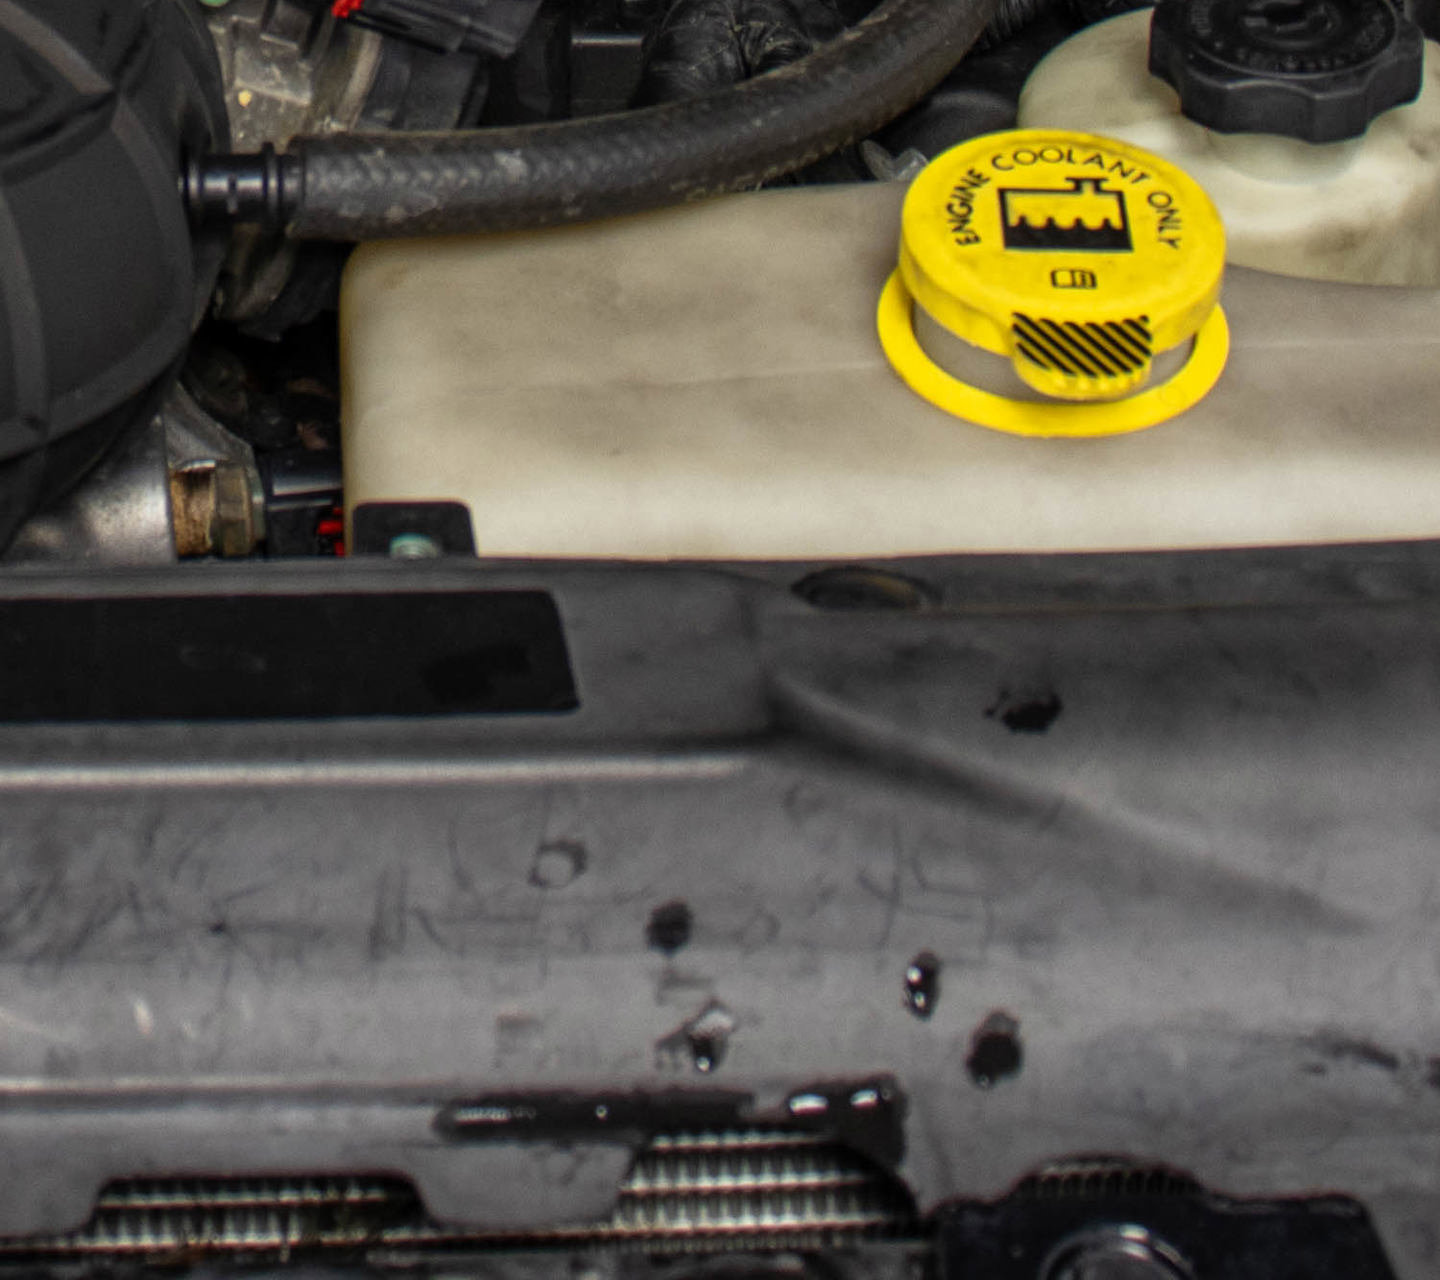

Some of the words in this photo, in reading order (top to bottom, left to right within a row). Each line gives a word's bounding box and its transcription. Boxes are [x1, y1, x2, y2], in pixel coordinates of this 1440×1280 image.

[946, 168, 991, 247] ENGINE
[991, 147, 1148, 184] COOLANT
[1147, 190, 1182, 250] ONLY
